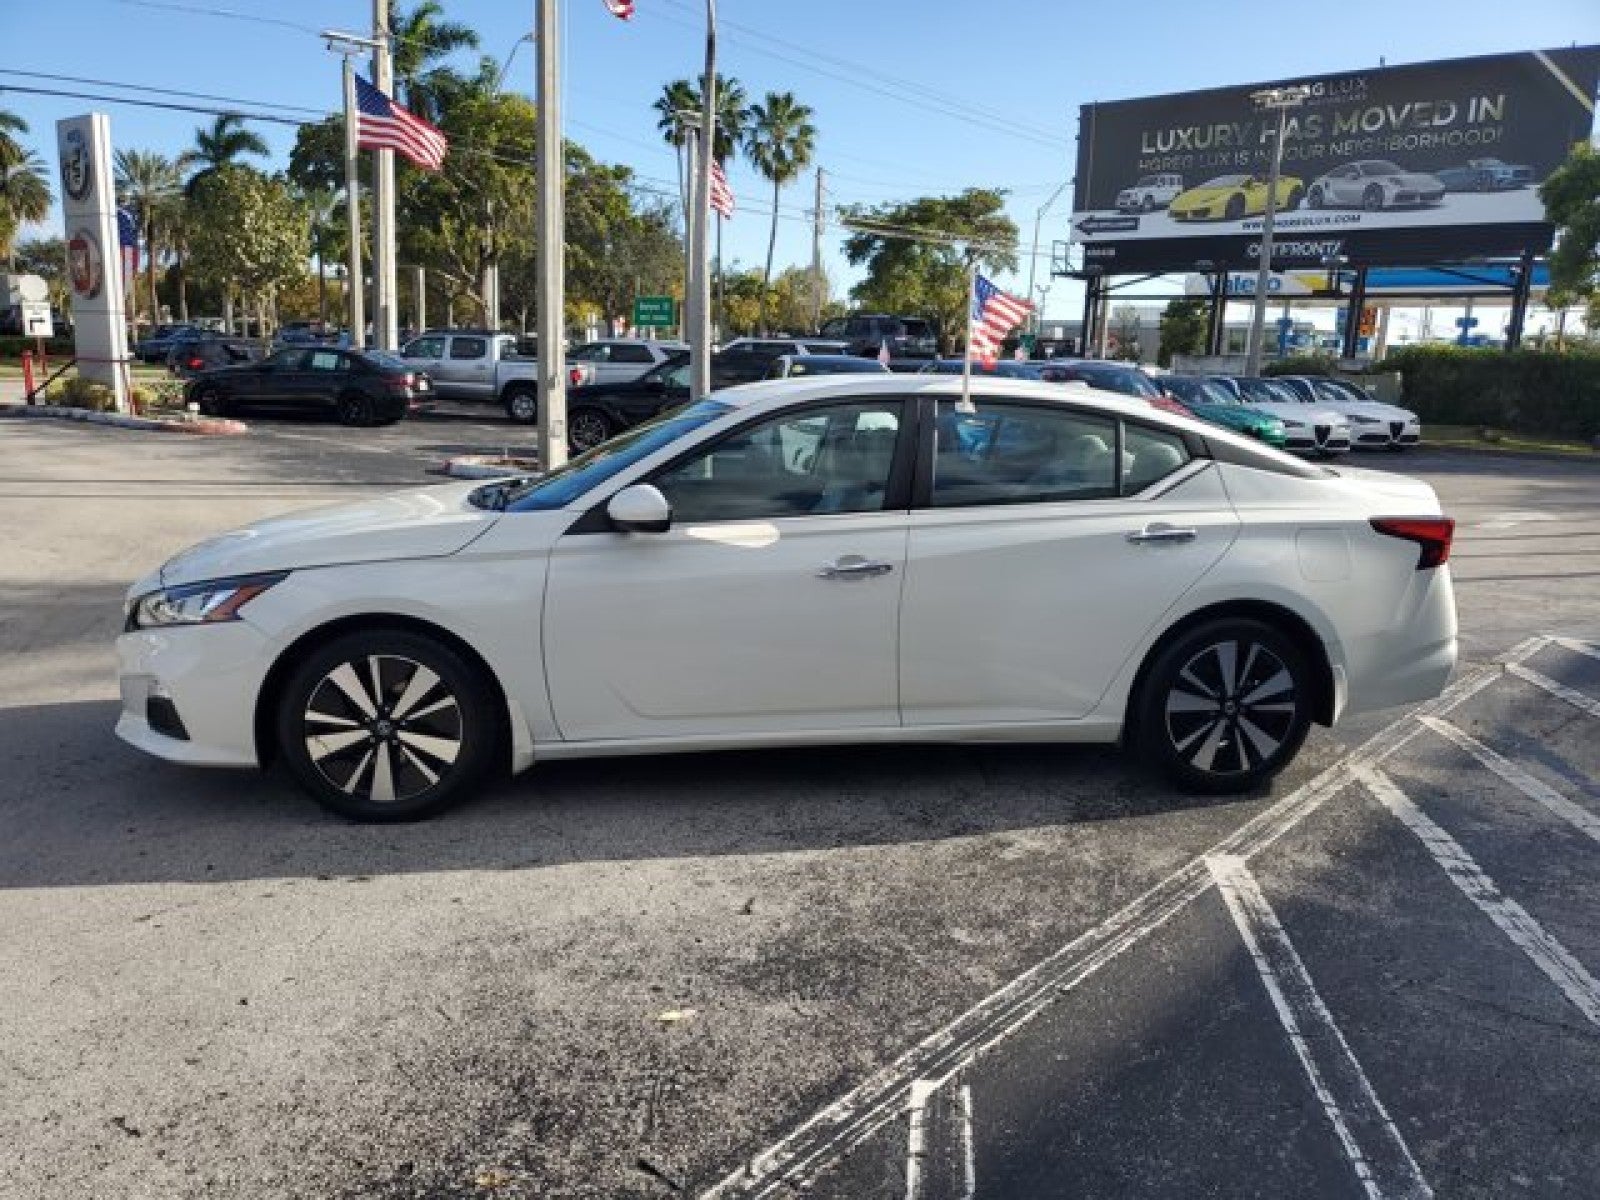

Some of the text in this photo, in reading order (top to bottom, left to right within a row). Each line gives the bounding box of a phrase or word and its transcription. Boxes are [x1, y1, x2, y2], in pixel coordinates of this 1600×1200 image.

[1141, 122, 1253, 153] LUXURY
[1259, 113, 1322, 145] HAS
[1332, 100, 1458, 136] MOVED
[1467, 94, 1506, 123] IN
[1206, 273, 1282, 292] Valeo
